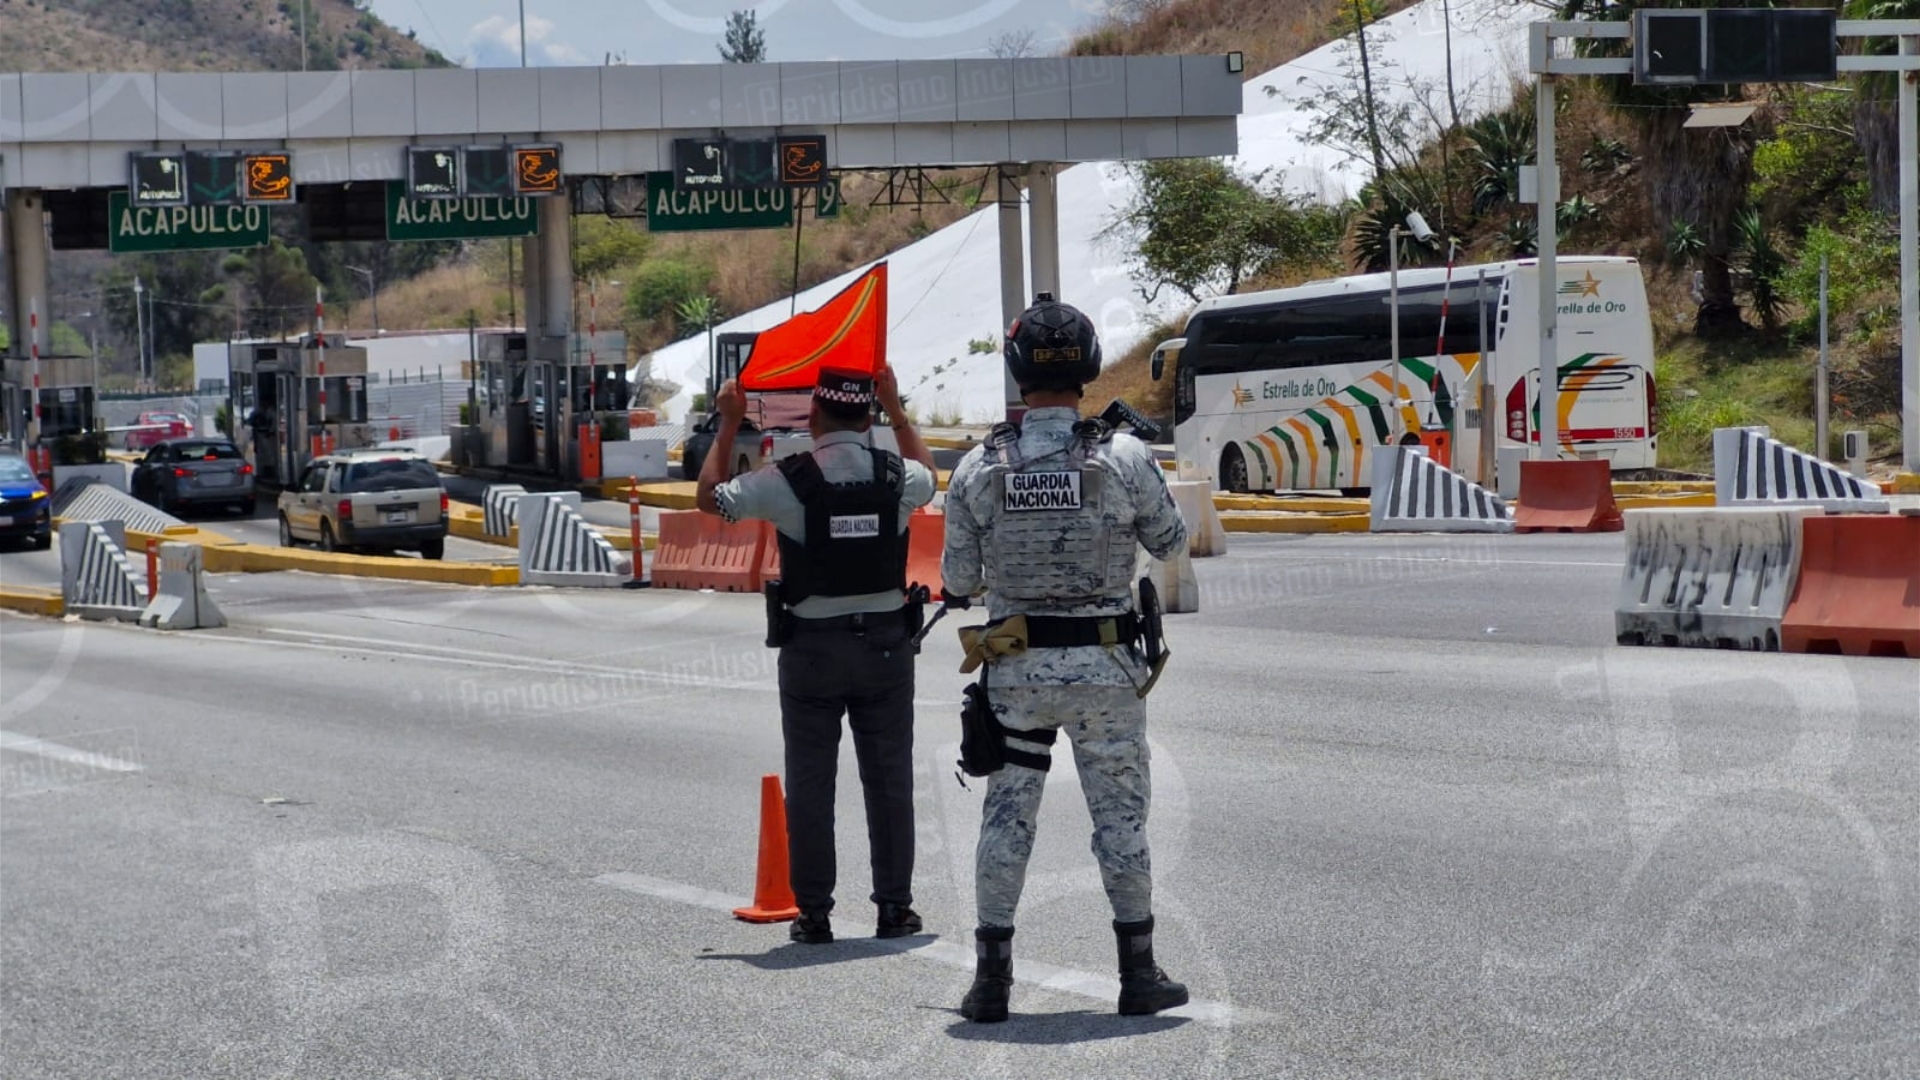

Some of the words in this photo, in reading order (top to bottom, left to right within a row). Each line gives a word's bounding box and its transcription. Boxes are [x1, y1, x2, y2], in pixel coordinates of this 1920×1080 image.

[656, 187, 785, 216] ACAPULCO
[822, 181, 836, 213] 9
[396, 196, 530, 225] ACAPULCO
[119, 204, 261, 237] ACAPULCO
[1557, 302, 1583, 314] rella
[1587, 301, 1601, 313] de
[1605, 301, 1626, 313] Oro
[842, 381, 860, 392] GN
[1263, 378, 1299, 399] Estrella
[1302, 379, 1314, 397] de
[1317, 377, 1336, 396] Oro
[1613, 428, 1635, 439] 1550
[1012, 473, 1072, 491] GUARDIA
[1007, 490, 1079, 508] NACIONAL
[831, 518, 852, 534] GUARDIA
[854, 517, 877, 533] NACIONAL
